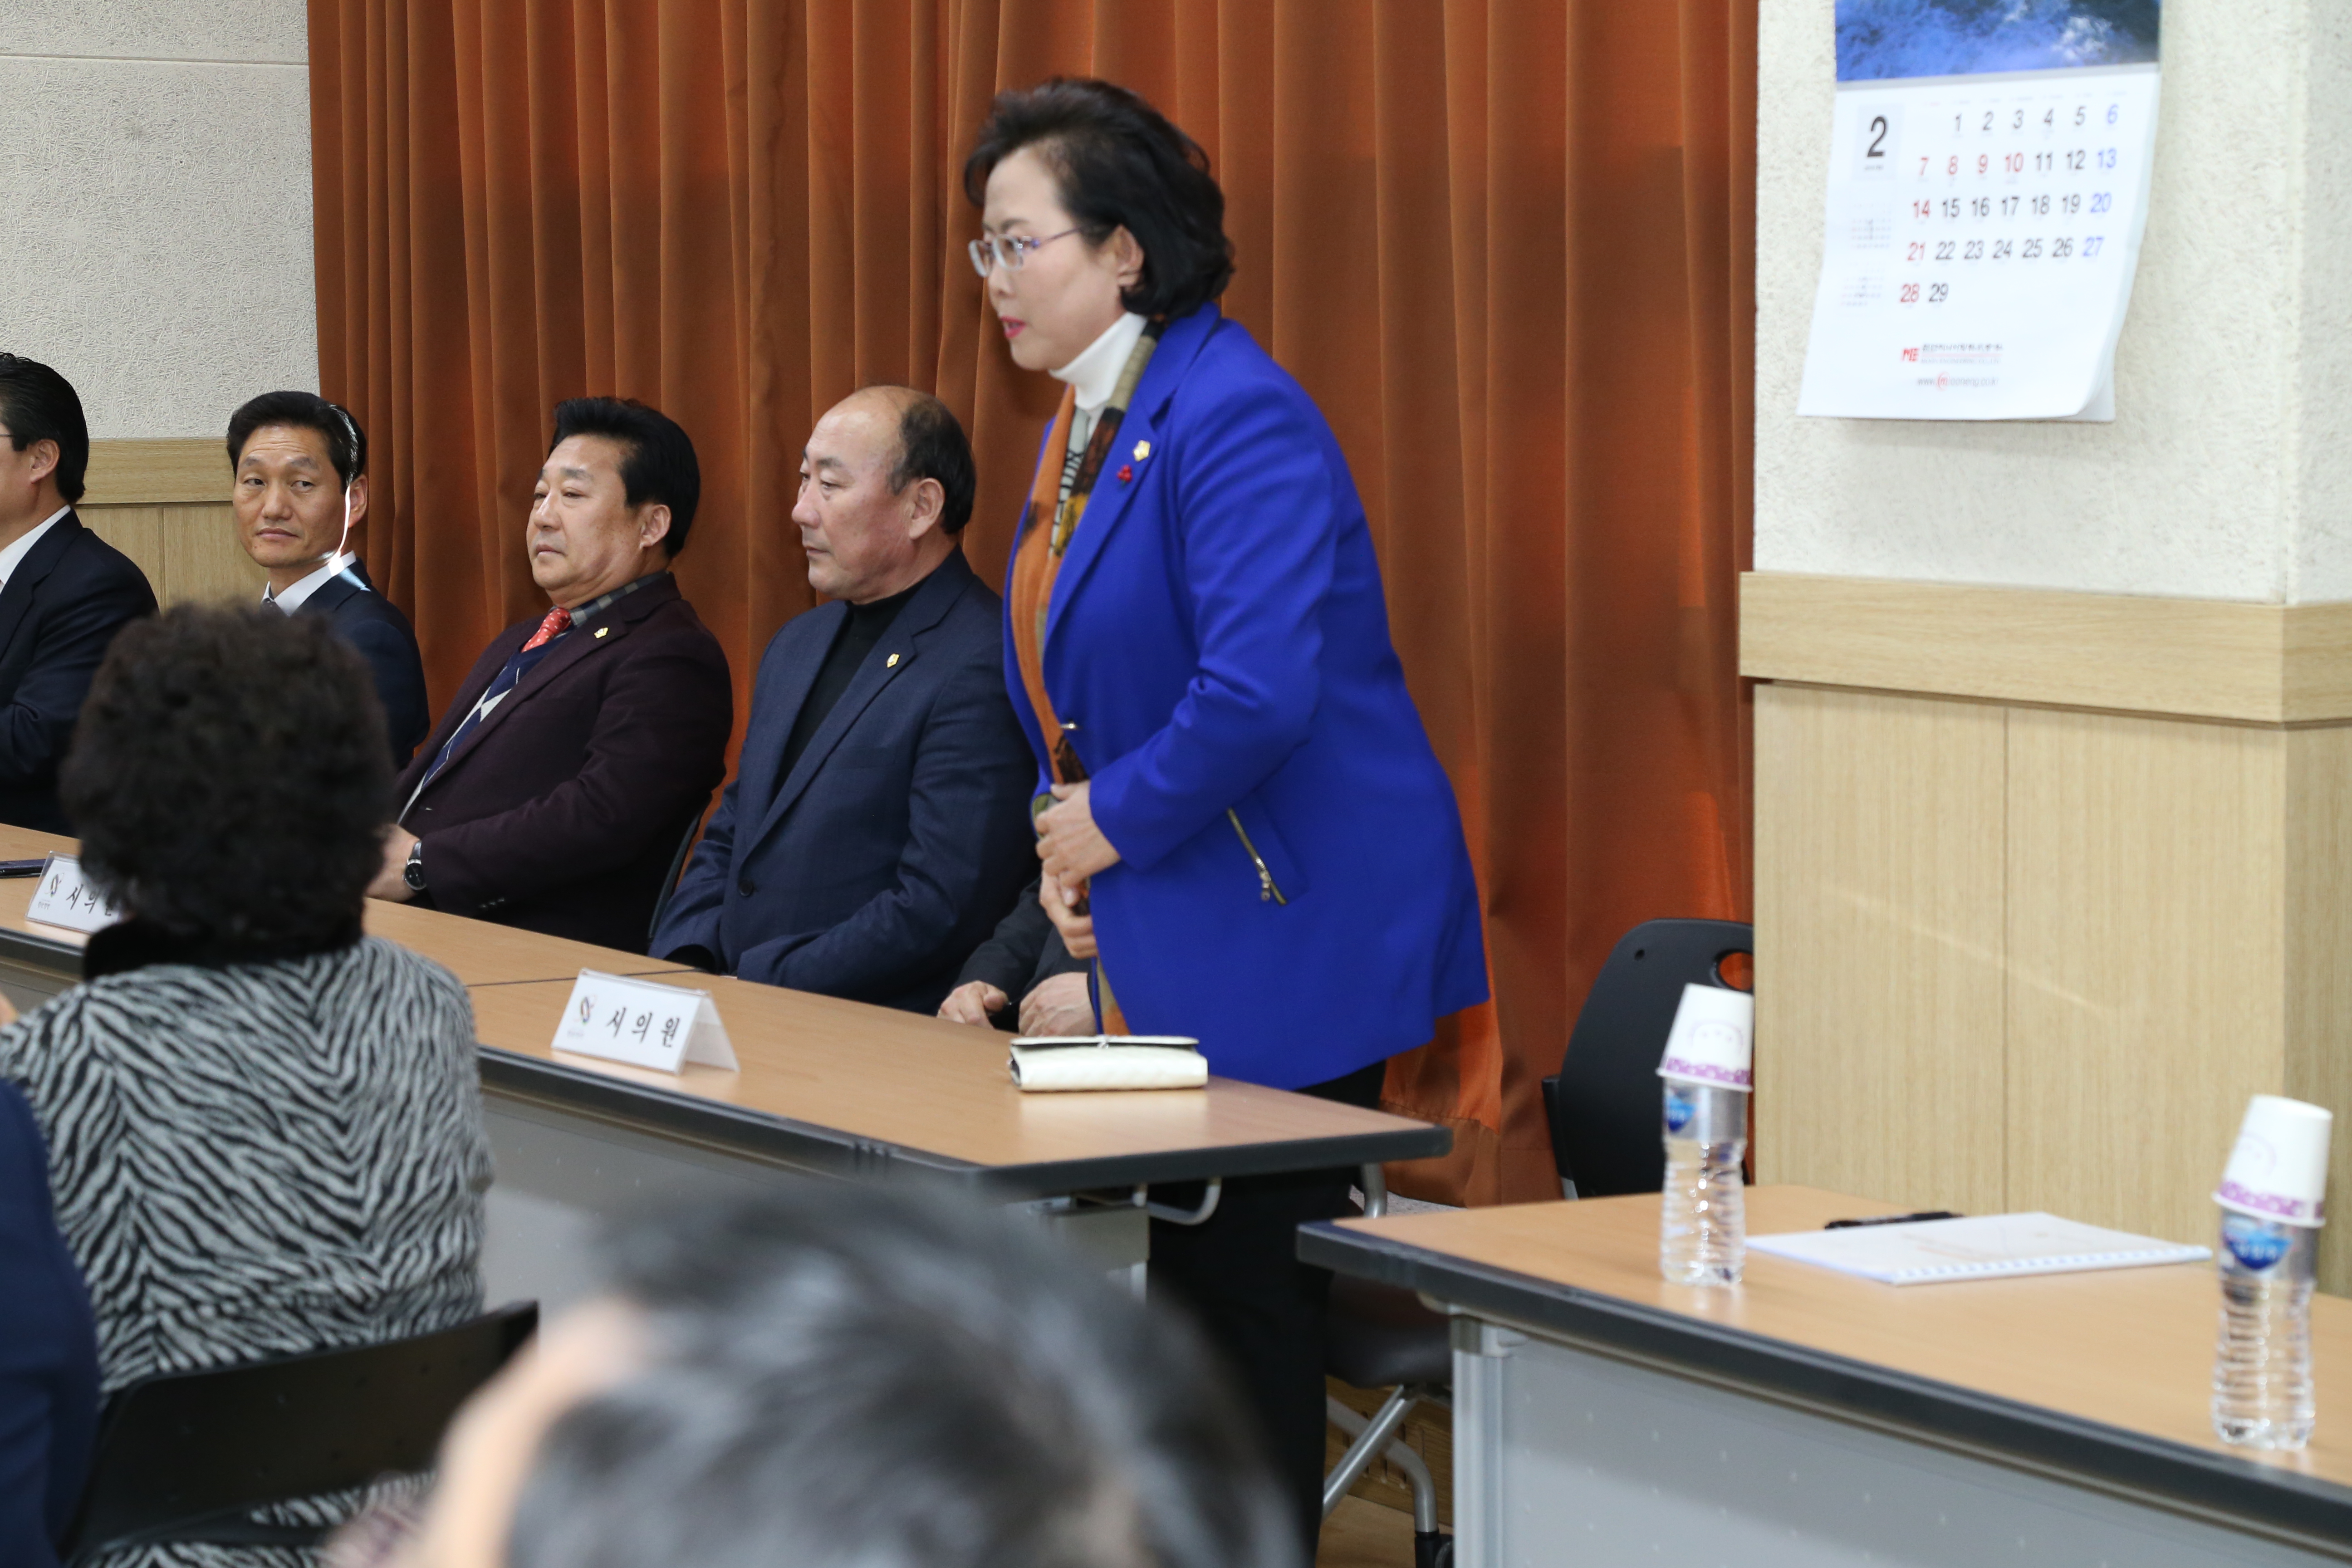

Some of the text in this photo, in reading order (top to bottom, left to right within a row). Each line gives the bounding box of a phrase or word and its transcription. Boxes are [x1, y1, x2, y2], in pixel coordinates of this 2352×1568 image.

[1955, 104, 2118, 132] 1 2 3 4 5 6
[1867, 116, 1887, 157] 2
[1920, 147, 2117, 176] 7 8 9 10 11 12 13
[1913, 192, 2112, 218] 14 15 16 17 18 19 20
[1907, 236, 2105, 261] 21 22 23 24 25 26 27
[1900, 283, 1920, 303] 28
[1929, 283, 1948, 302] 29
[66, 883, 116, 916] 시의
[606, 1006, 680, 1048] 시의원
